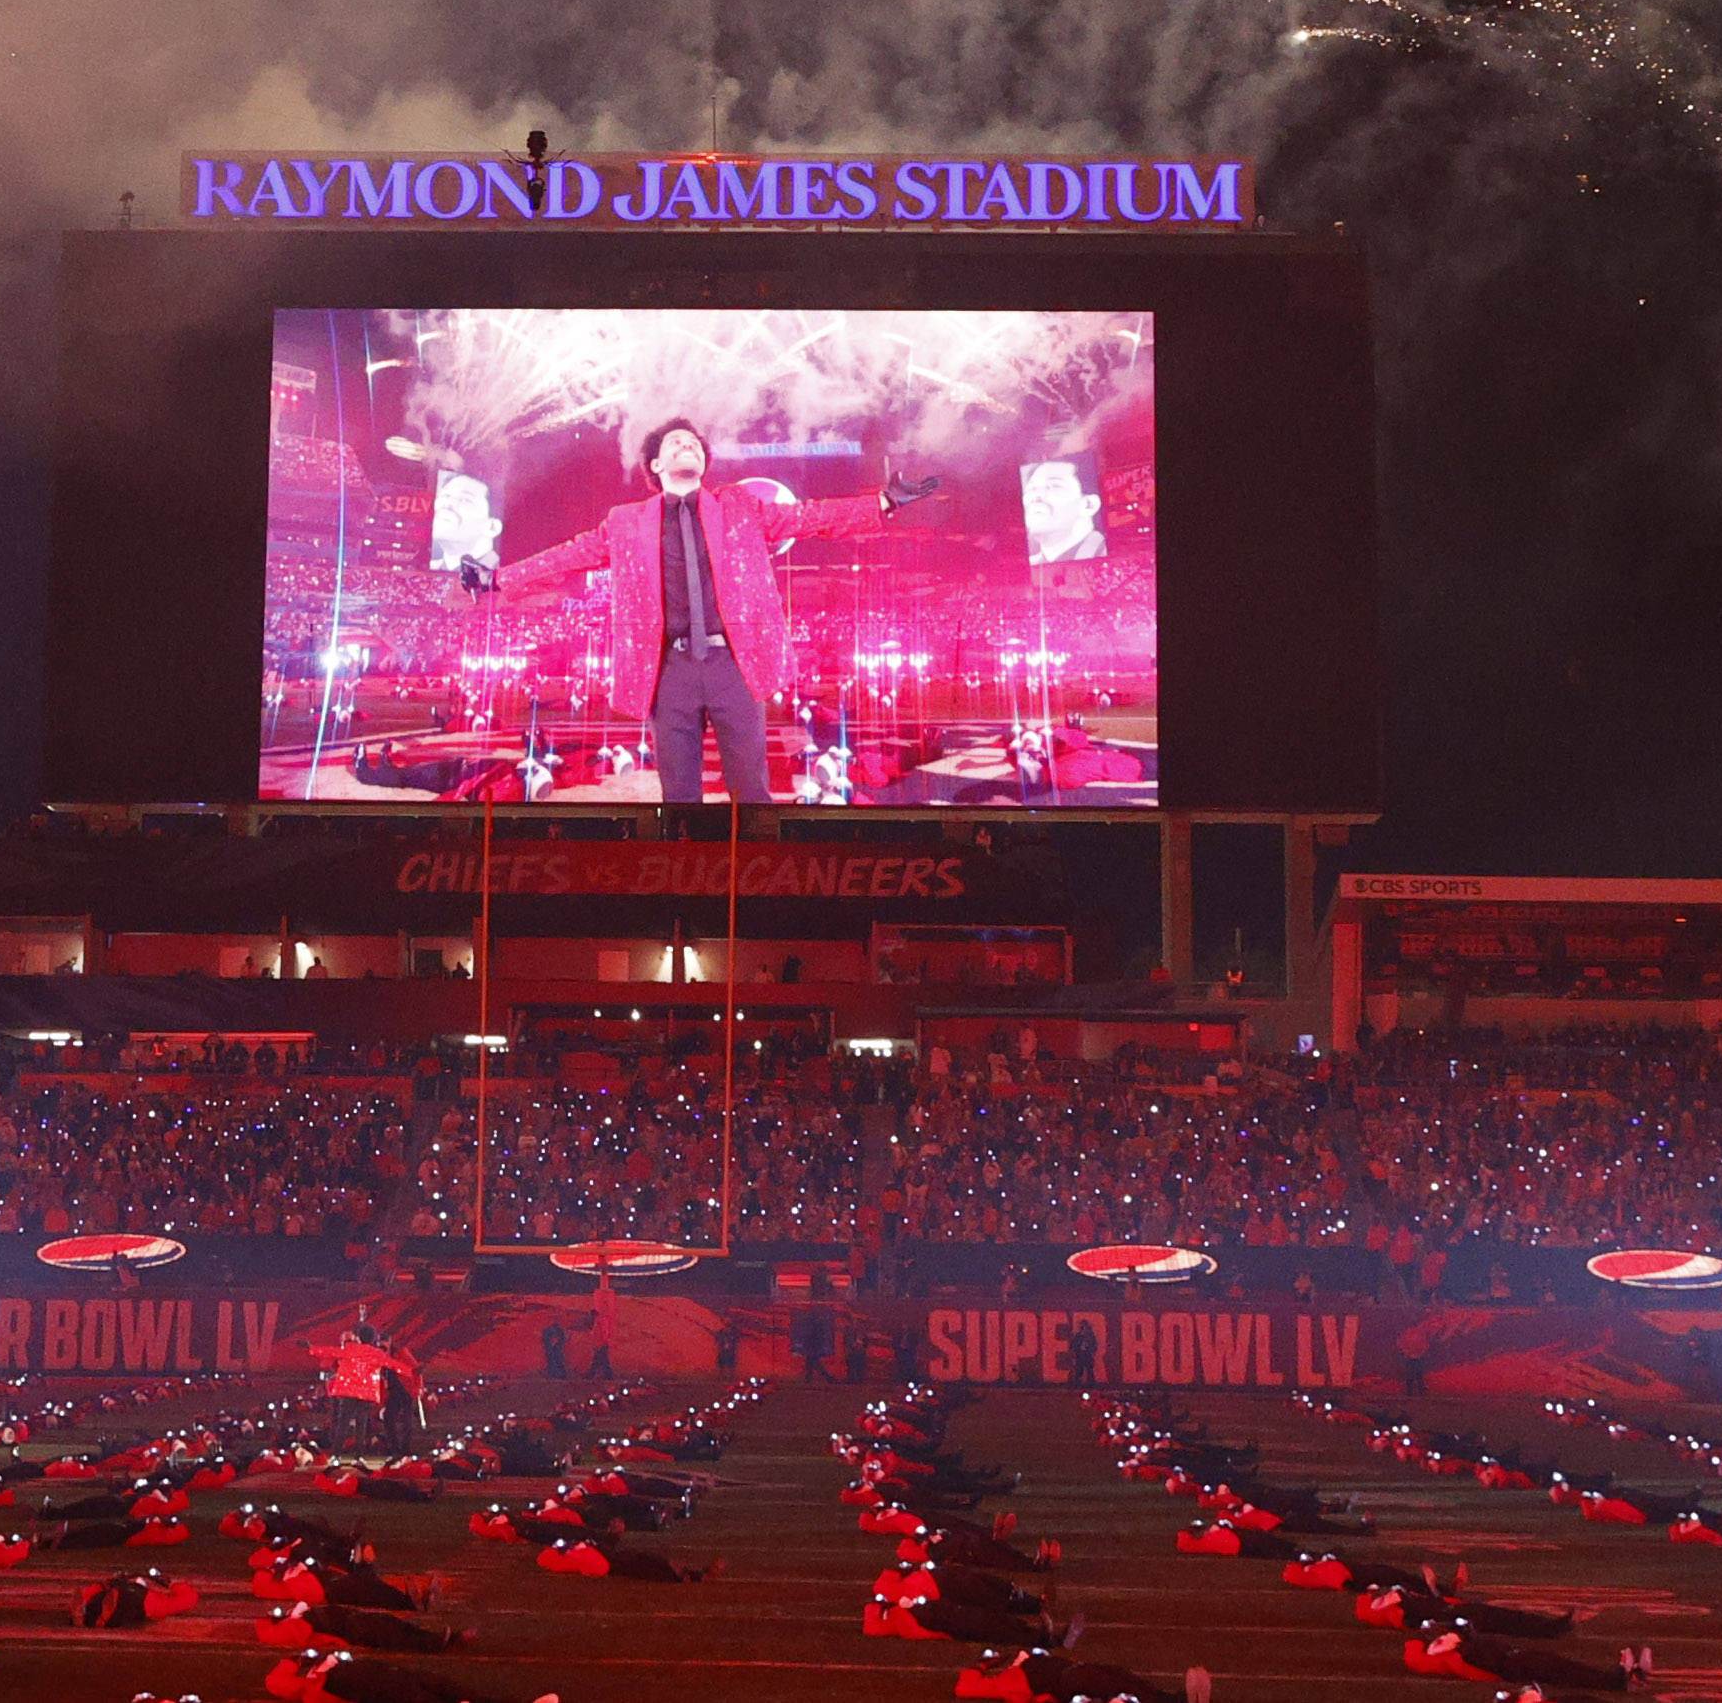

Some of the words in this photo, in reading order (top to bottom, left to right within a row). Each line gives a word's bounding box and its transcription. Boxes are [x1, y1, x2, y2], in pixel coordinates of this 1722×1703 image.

[191, 158, 602, 221] RAYMOND
[613, 159, 878, 222] JAMES
[893, 160, 1243, 223] STADIUM
[395, 852, 573, 896] CHIEFS
[629, 852, 966, 898] BUCCANEERS
[1369, 879, 1406, 894] CBS
[1409, 880, 1483, 896] SPORTS
[43, 1298, 203, 1372] BOWL
[216, 1300, 281, 1373] LV
[926, 1308, 1111, 1385] SUPER
[1120, 1310, 1286, 1387] BOWL
[1296, 1313, 1361, 1389] LV
